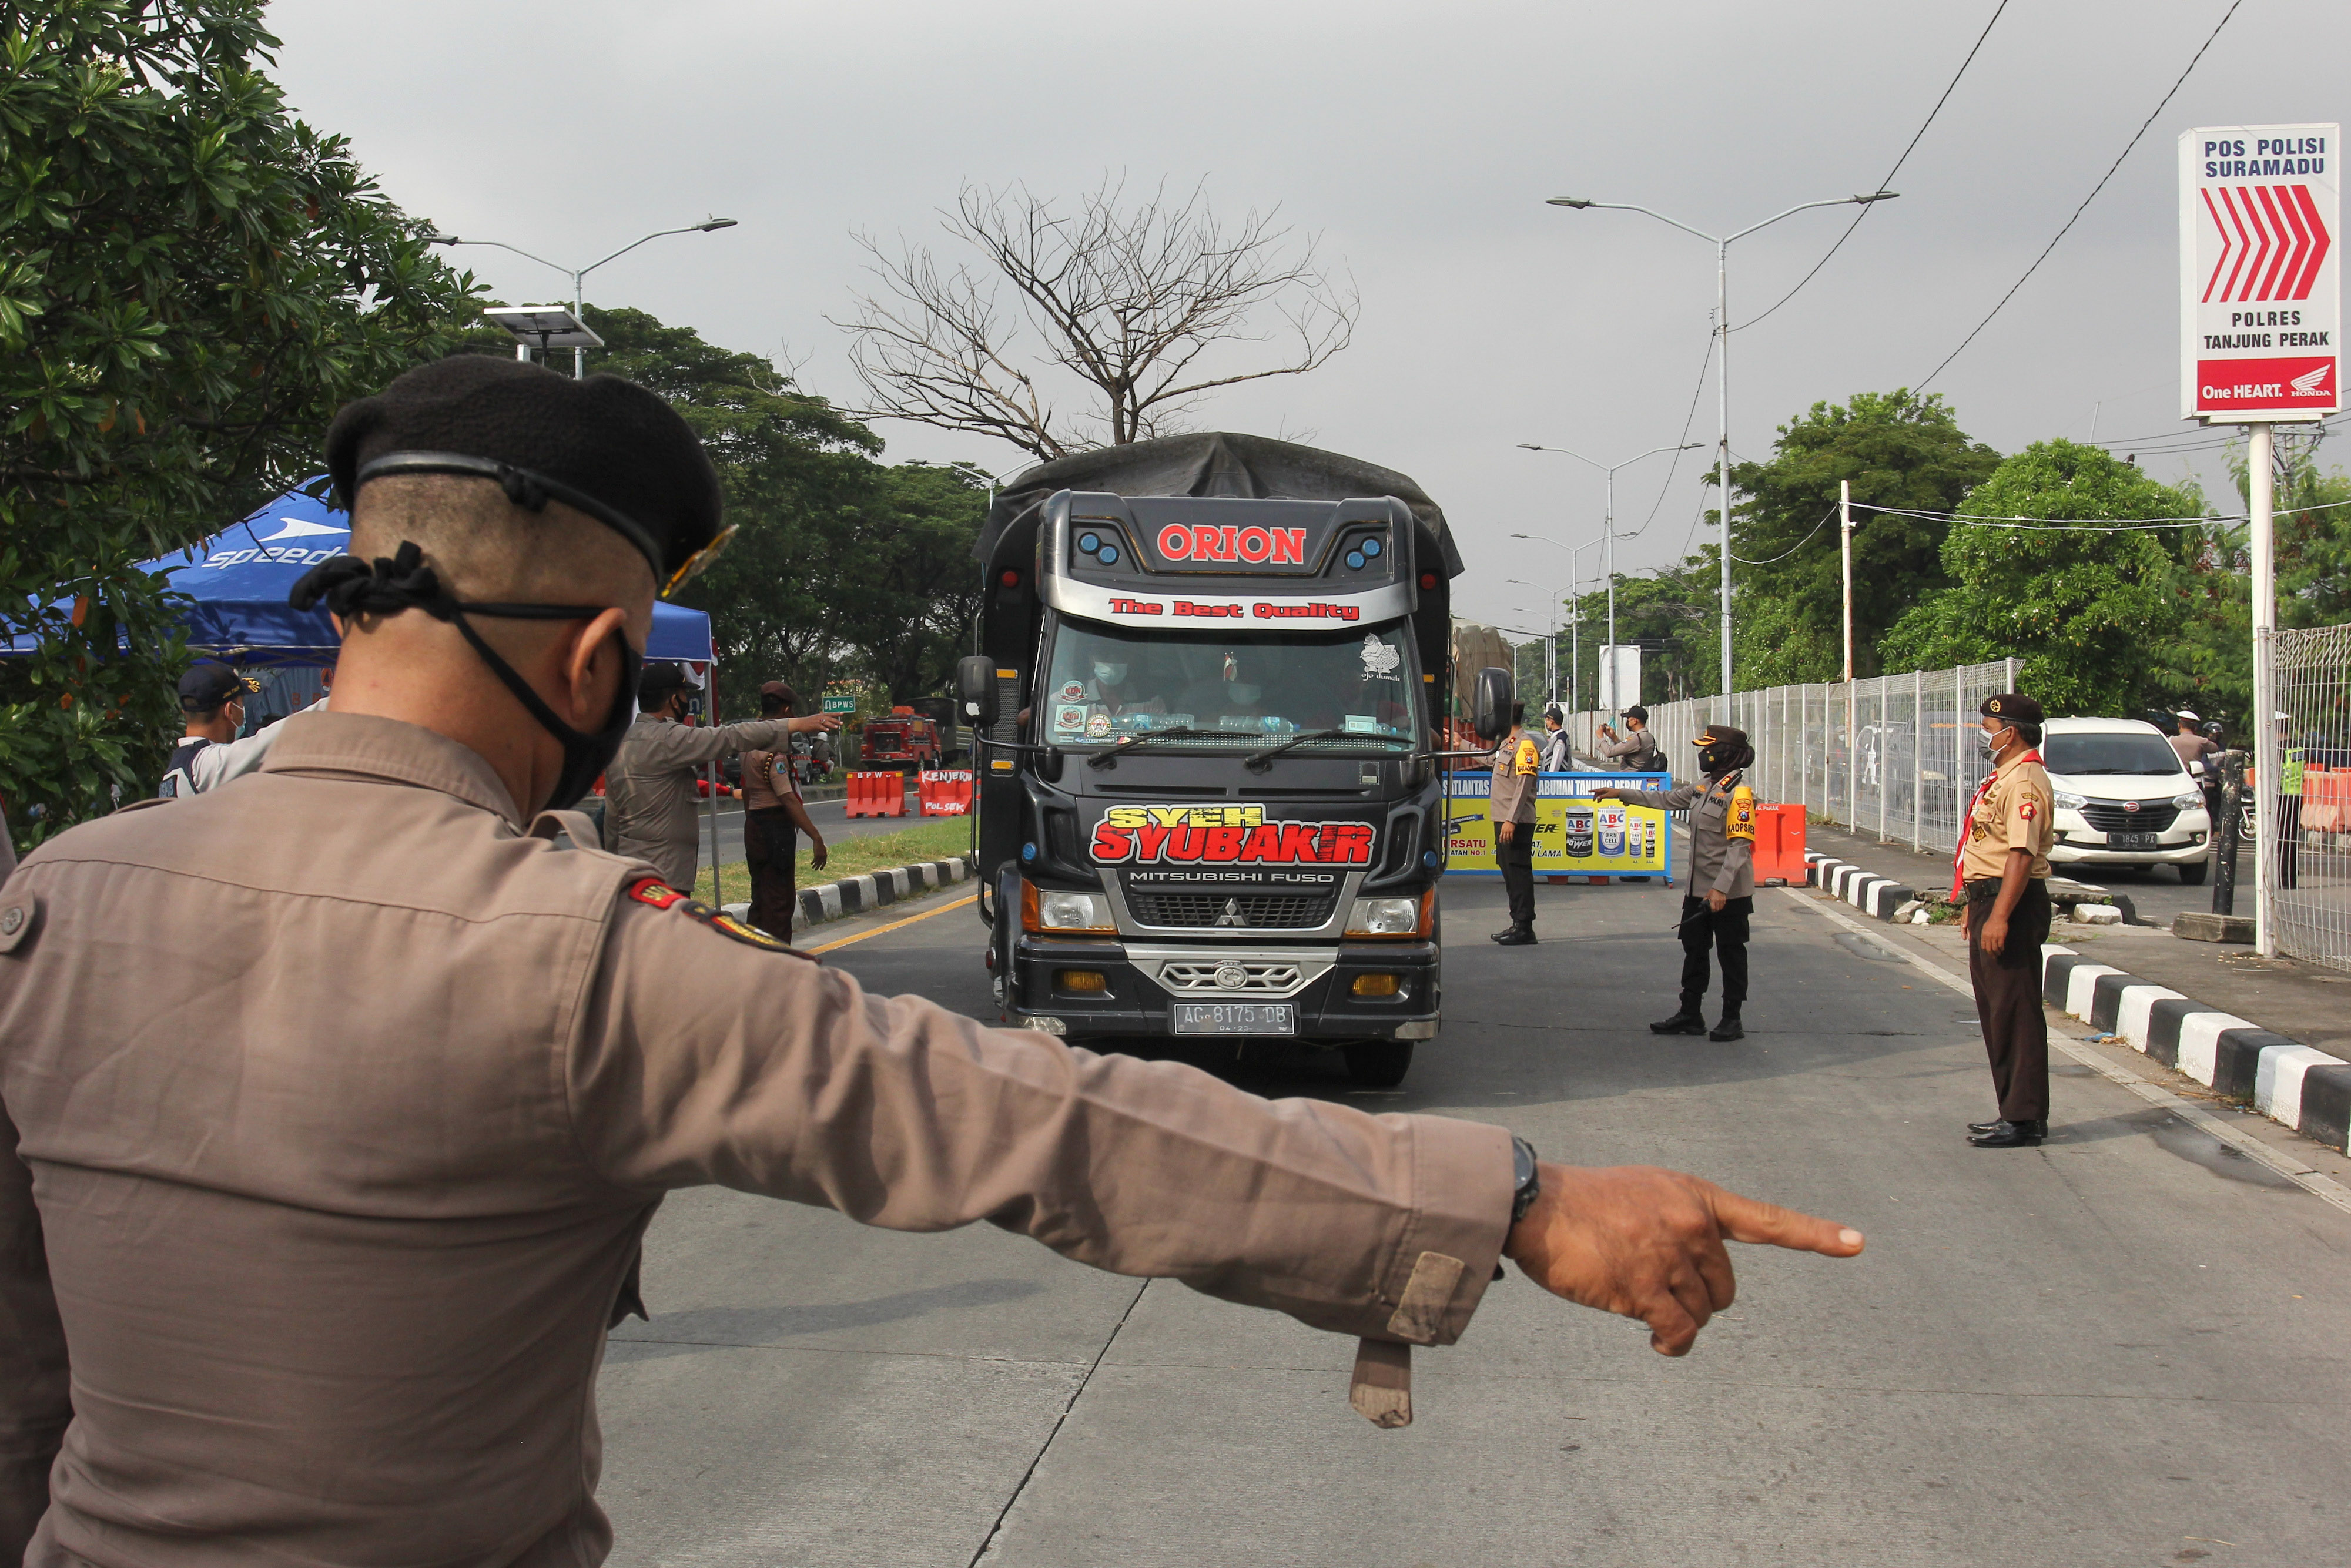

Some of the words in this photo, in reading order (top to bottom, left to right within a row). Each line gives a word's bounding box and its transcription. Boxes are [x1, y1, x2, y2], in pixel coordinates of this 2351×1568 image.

[2205, 140, 2245, 157] POS
[2258, 138, 2325, 156] POLISI
[2206, 158, 2324, 178] SURAMADU
[2232, 310, 2301, 327] POLRES
[2204, 333, 2272, 349] TANJUNG
[2280, 331, 2329, 347] PERAK
[2202, 385, 2231, 400] One
[2233, 383, 2283, 398] HEART.
[2290, 389, 2332, 397] HONDA
[1157, 522, 1307, 565] ORION
[1108, 598, 1164, 615] The
[1172, 600, 1244, 618] Best
[1253, 602, 1359, 621] Quality
[1709, 796, 1724, 807] POLRI
[1108, 807, 1262, 829] SYEH
[1568, 820, 1590, 829] ABC
[1599, 813, 1623, 823] ABC
[1092, 824, 1374, 863] SYUBAKIR
[1566, 839, 1592, 849] POWER
[2109, 835, 2113, 843] L
[2122, 835, 2138, 843] 1845
[2145, 835, 2154, 843] PX
[1130, 872, 1262, 881] MITSUBISHI
[1271, 873, 1334, 883] FUSO
[1184, 1006, 1203, 1023] AG
[1213, 1006, 1255, 1023] 8175
[1264, 1006, 1286, 1023] DB
